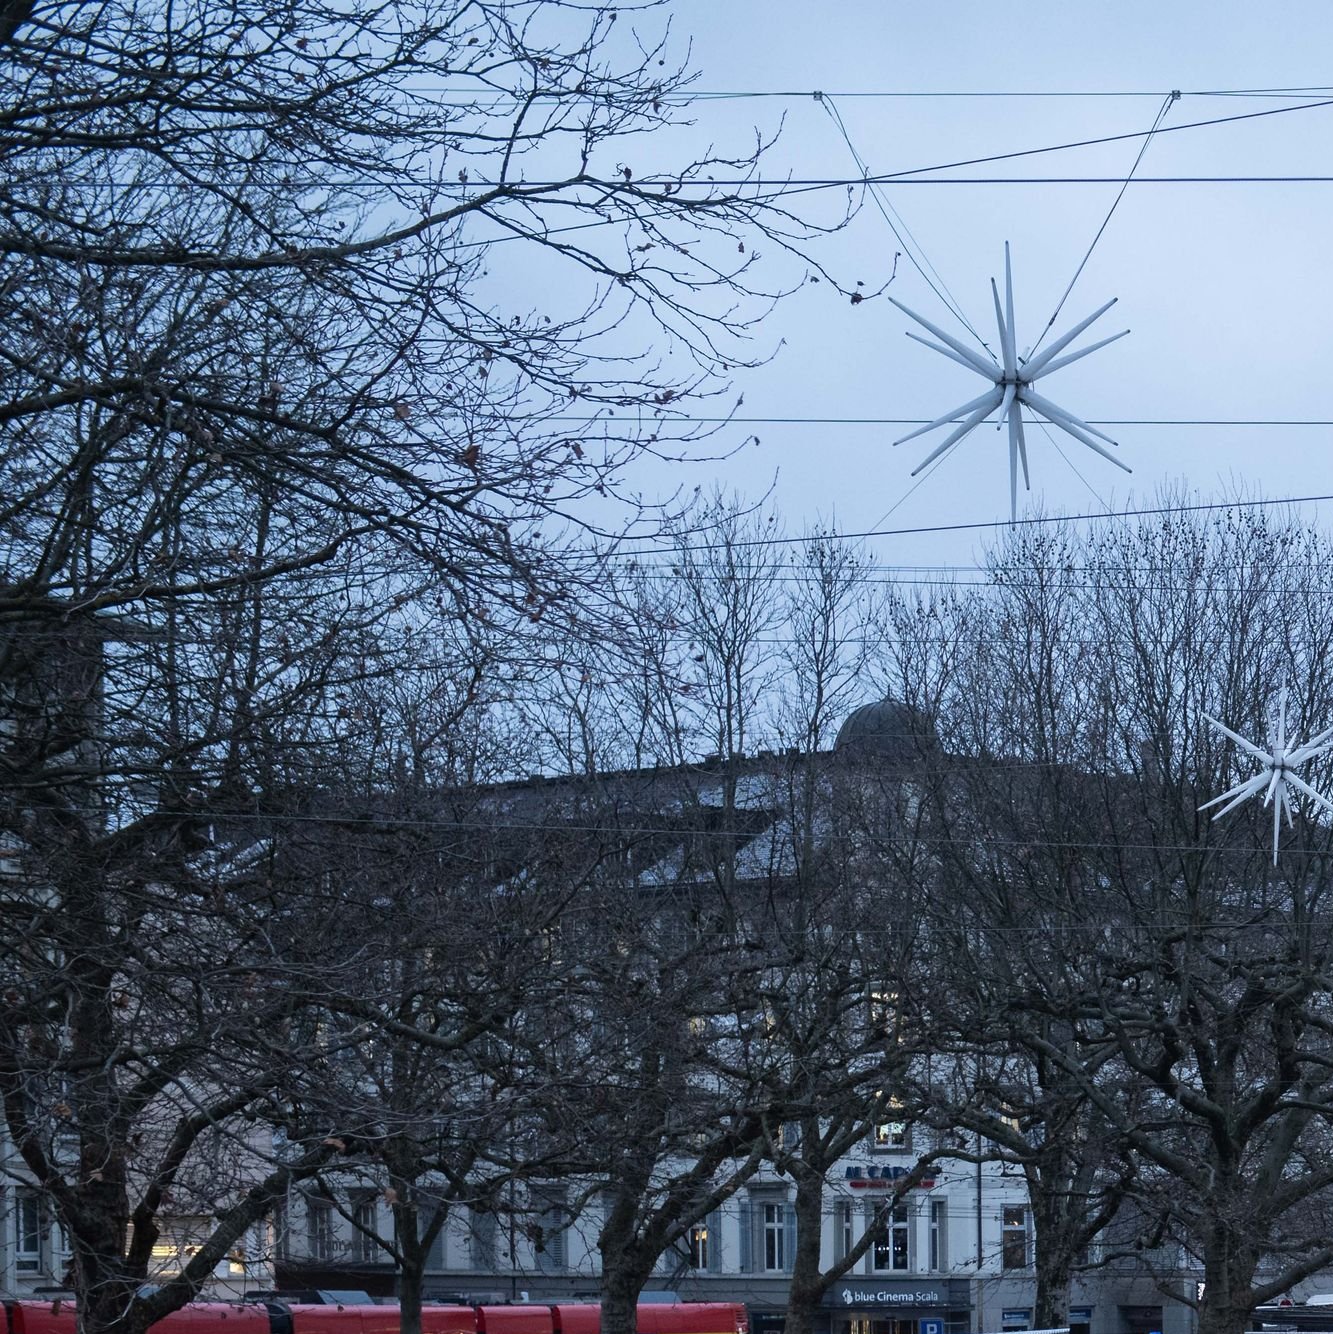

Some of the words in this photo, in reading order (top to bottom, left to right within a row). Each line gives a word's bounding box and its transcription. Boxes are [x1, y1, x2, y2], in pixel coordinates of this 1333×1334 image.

[854, 1291, 875, 1301] blue
[877, 1291, 914, 1301] Cinema
[916, 1291, 938, 1301] Scala
